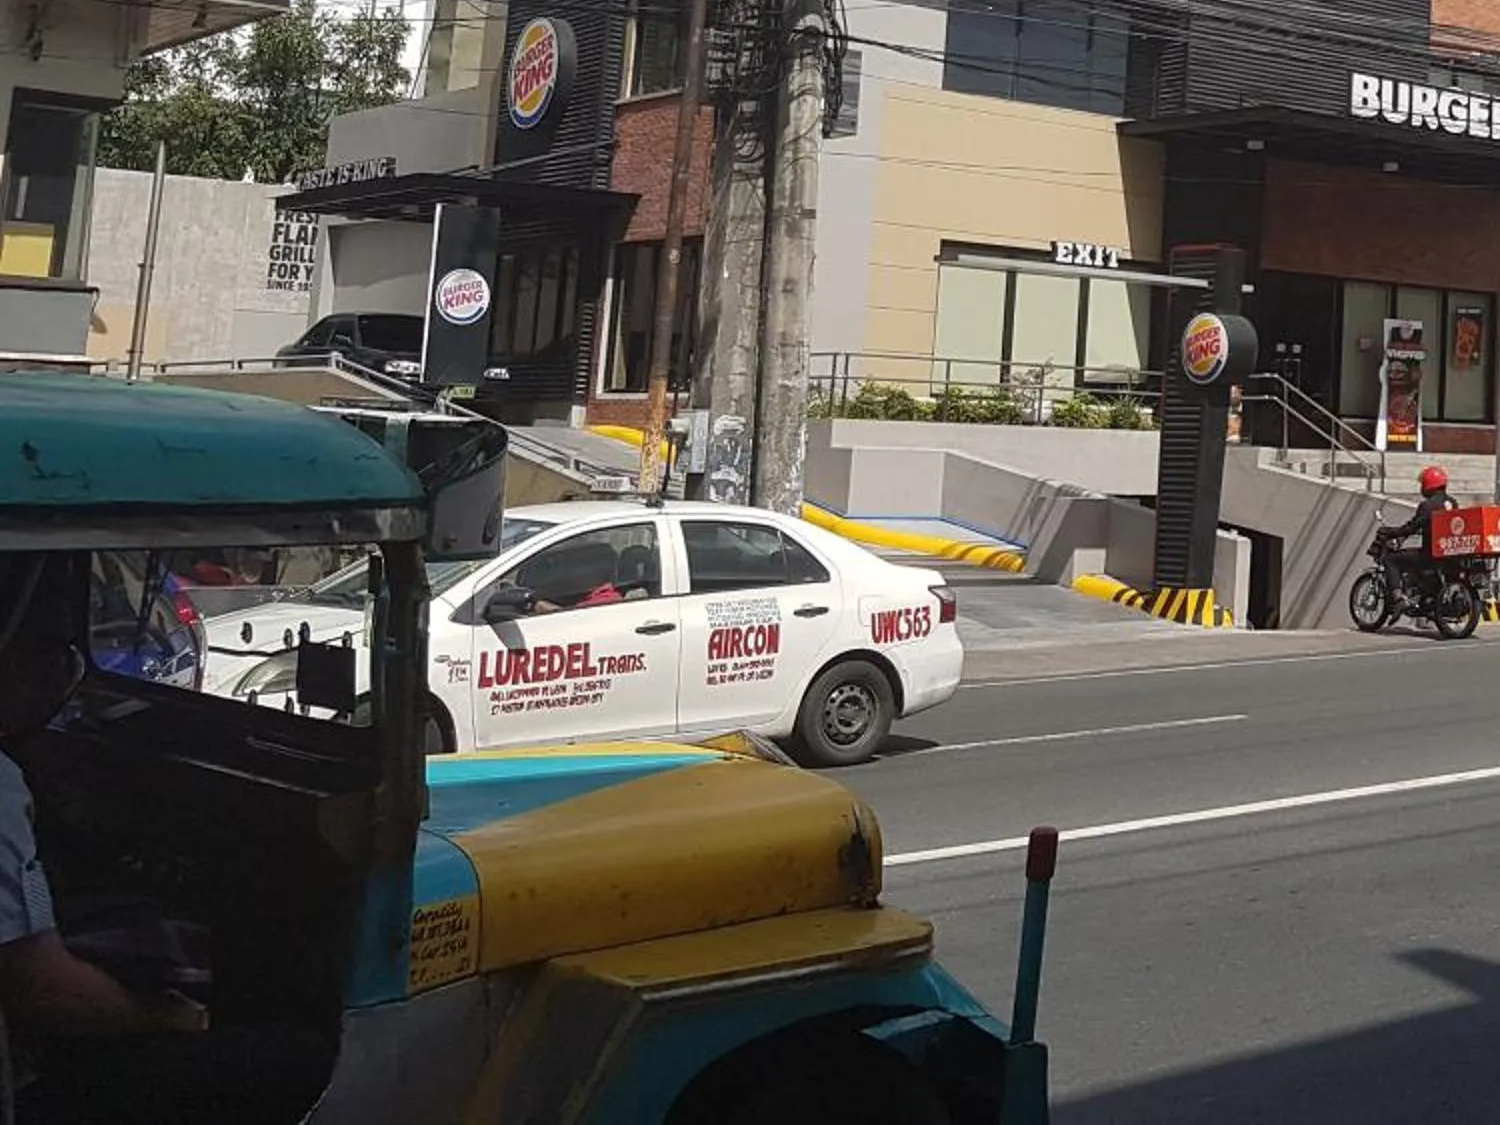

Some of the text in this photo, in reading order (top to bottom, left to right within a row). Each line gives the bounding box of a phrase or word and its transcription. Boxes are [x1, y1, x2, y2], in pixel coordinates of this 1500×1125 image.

[514, 33, 554, 79] BURGER
[514, 51, 554, 102] KING
[268, 262, 300, 280] FOR
[1054, 242, 1120, 268] EXIT
[443, 290, 484, 309] KING
[1186, 338, 1221, 365] KING
[708, 623, 780, 660] AIRCON
[478, 642, 598, 689] LUREDEL
